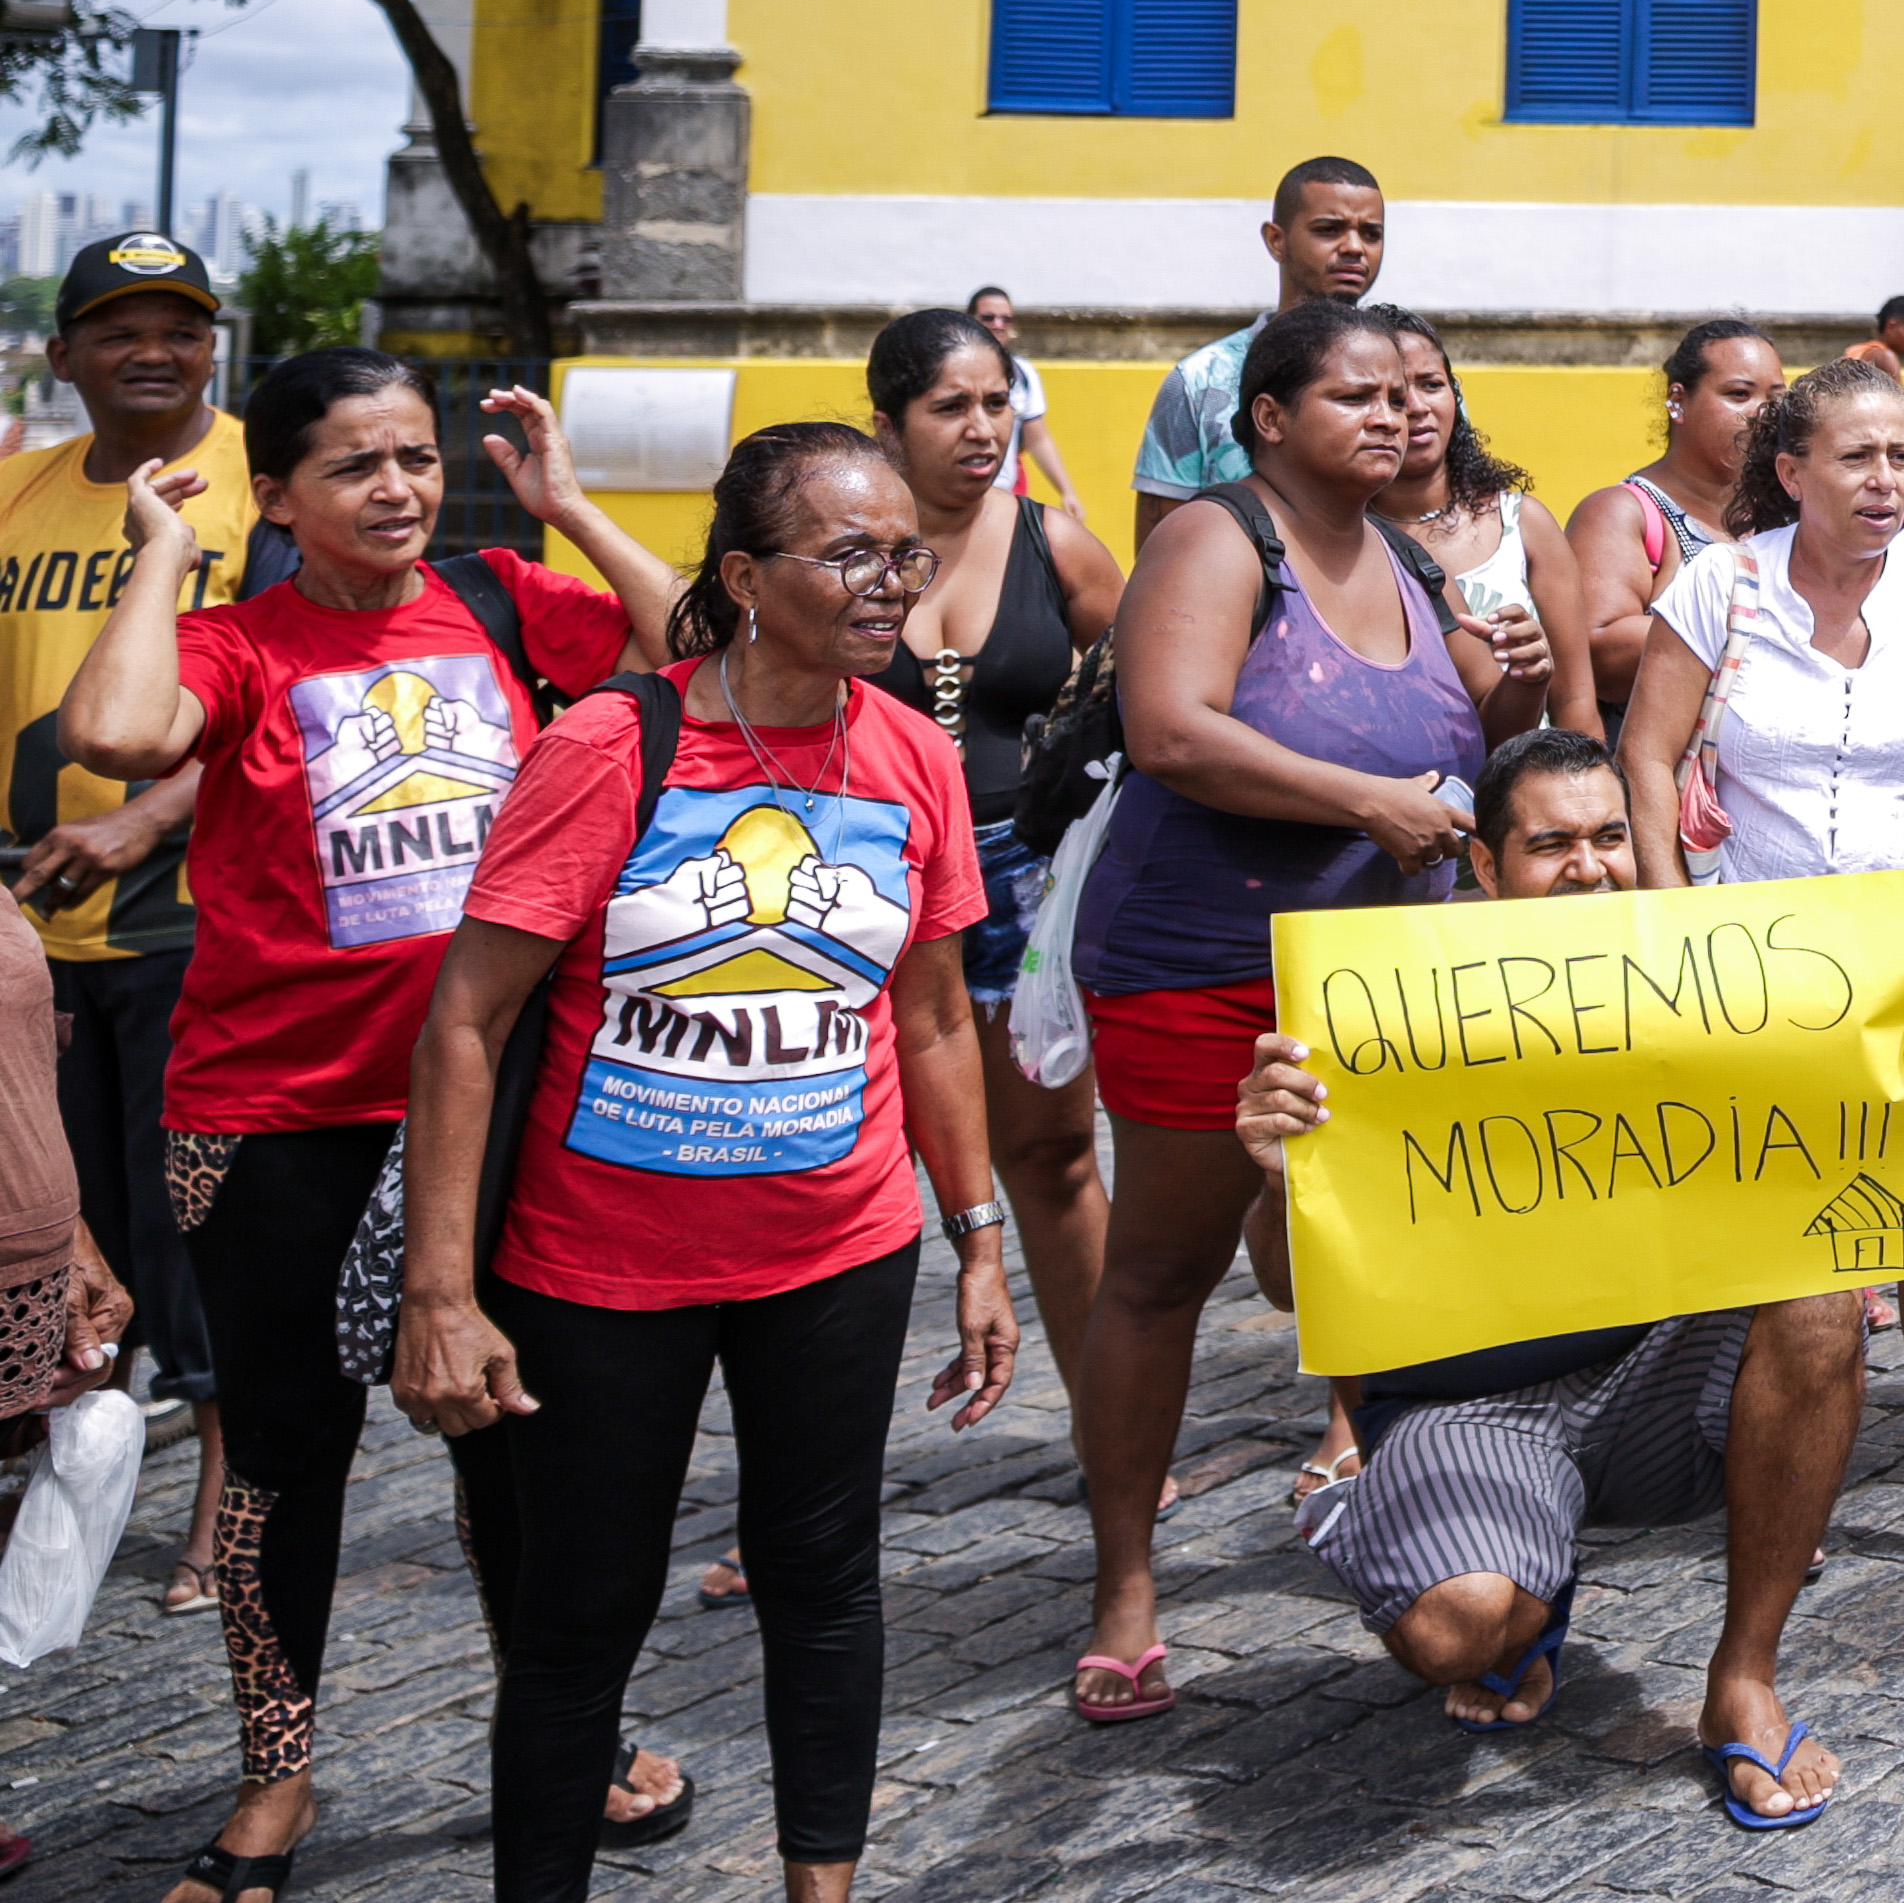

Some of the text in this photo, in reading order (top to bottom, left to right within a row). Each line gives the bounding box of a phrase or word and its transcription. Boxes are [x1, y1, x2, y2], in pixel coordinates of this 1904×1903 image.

[338, 897, 454, 928] DE LUTA PELA
[1322, 913, 1853, 1076] QUEREMOS
[612, 994, 862, 1067] MNLM
[602, 1075, 743, 1117] MOVIMENTO
[592, 1098, 853, 1139] DE LUTA PELA MORADIA
[676, 1143, 768, 1163] BRASIL
